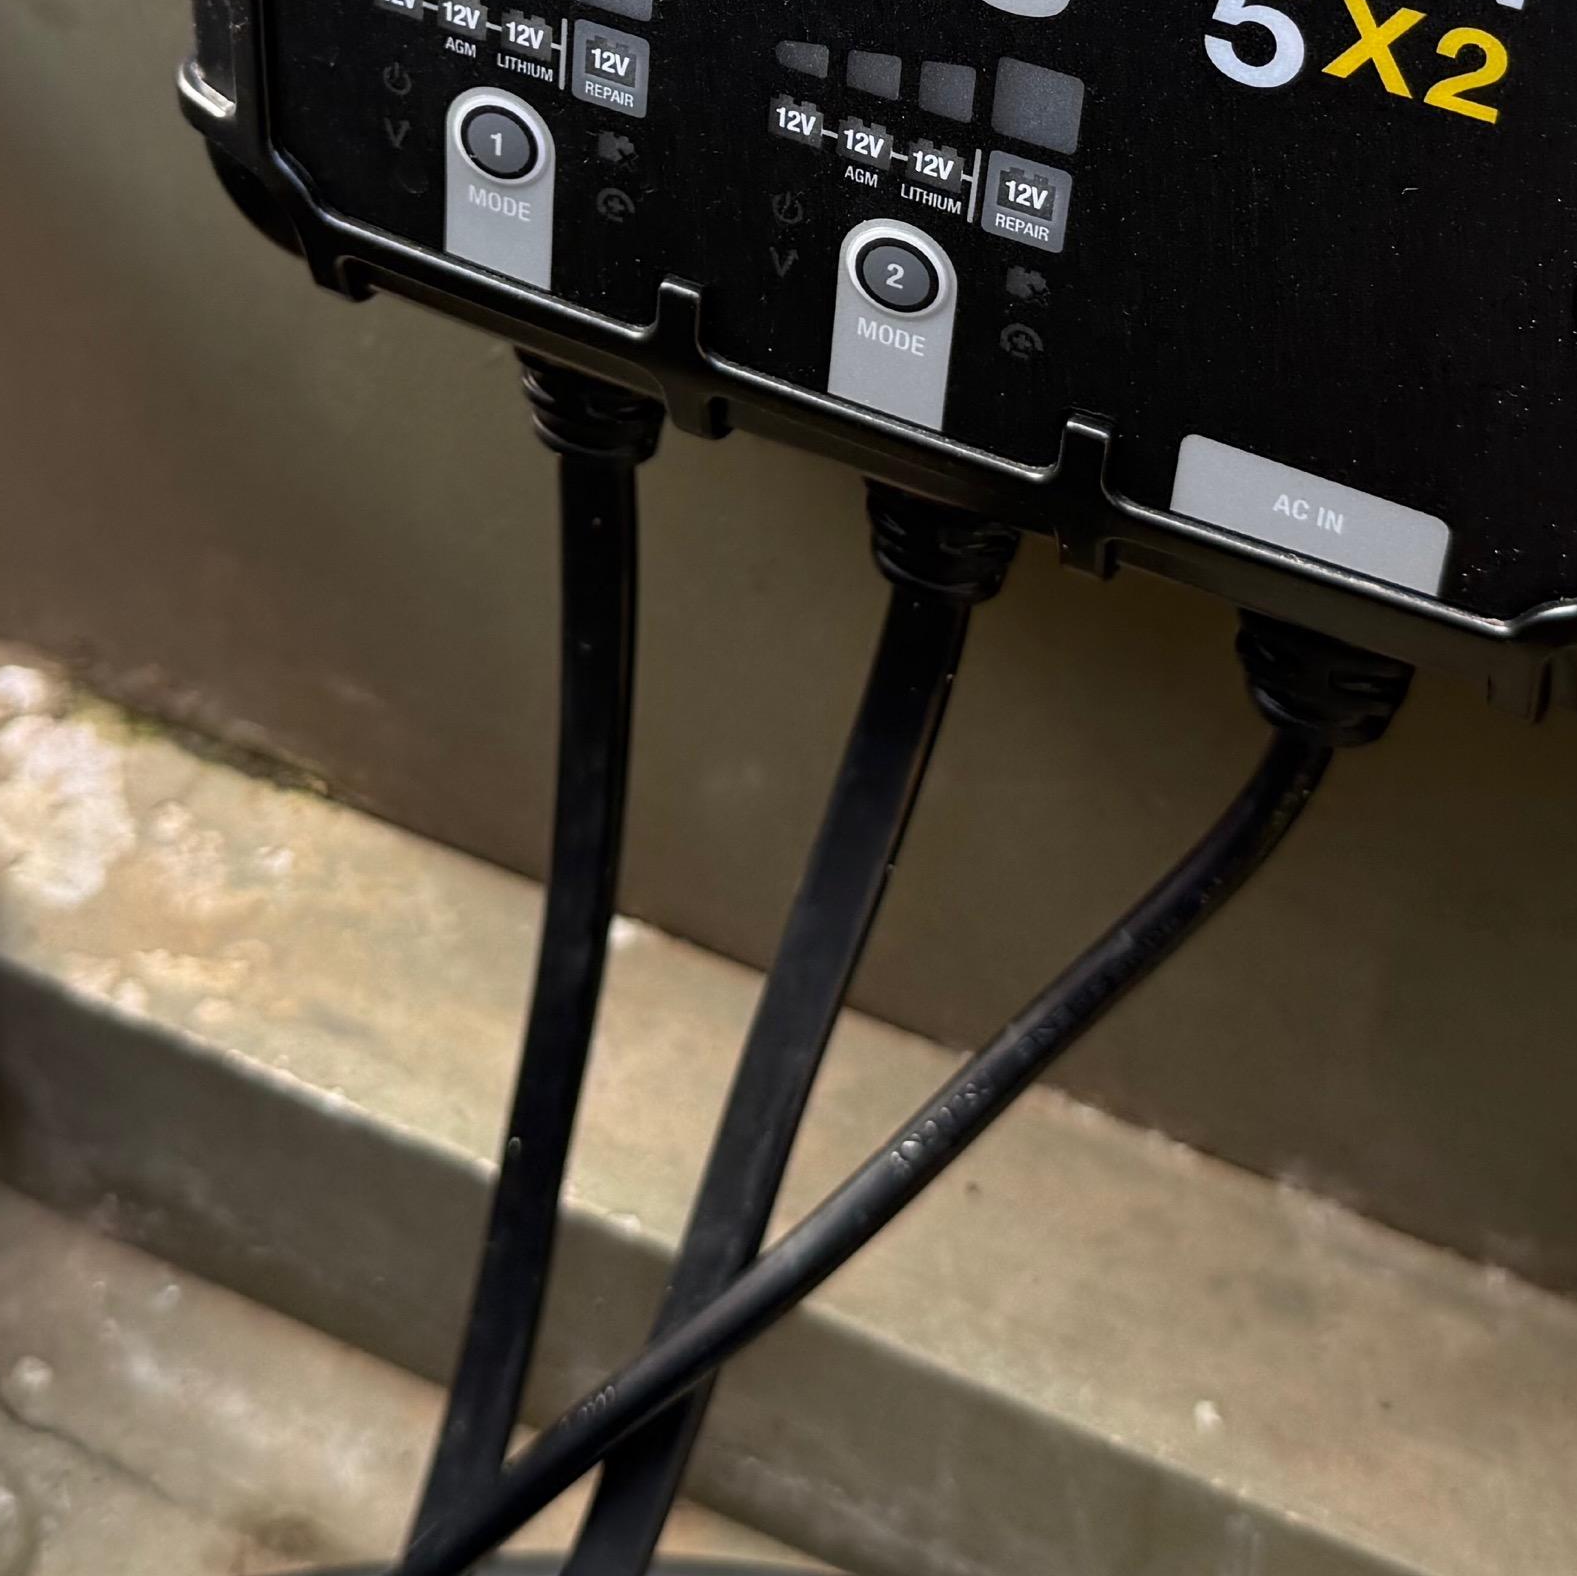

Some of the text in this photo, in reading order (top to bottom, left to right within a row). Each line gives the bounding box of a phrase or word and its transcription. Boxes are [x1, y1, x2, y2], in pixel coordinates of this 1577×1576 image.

[442, 0, 481, 30] 12V
[444, 35, 477, 59] AGM
[505, 21, 544, 50] 12V
[496, 52, 554, 83] LITHIUM
[590, 47, 630, 77] 12V
[584, 80, 635, 109] REPAIR
[775, 106, 817, 137] 12V
[488, 132, 504, 157] 1
[843, 128, 885, 159] 12V
[844, 165, 879, 189] AGM
[912, 150, 955, 181] 12V
[467, 184, 532, 222] MODE
[900, 183, 963, 215] LITHIUM
[1004, 179, 1049, 211] 12V
[994, 212, 1051, 243] REPAIR
[885, 262, 905, 290] 2
[856, 316, 927, 357] MODE
[1272, 493, 1345, 535] AC IN
